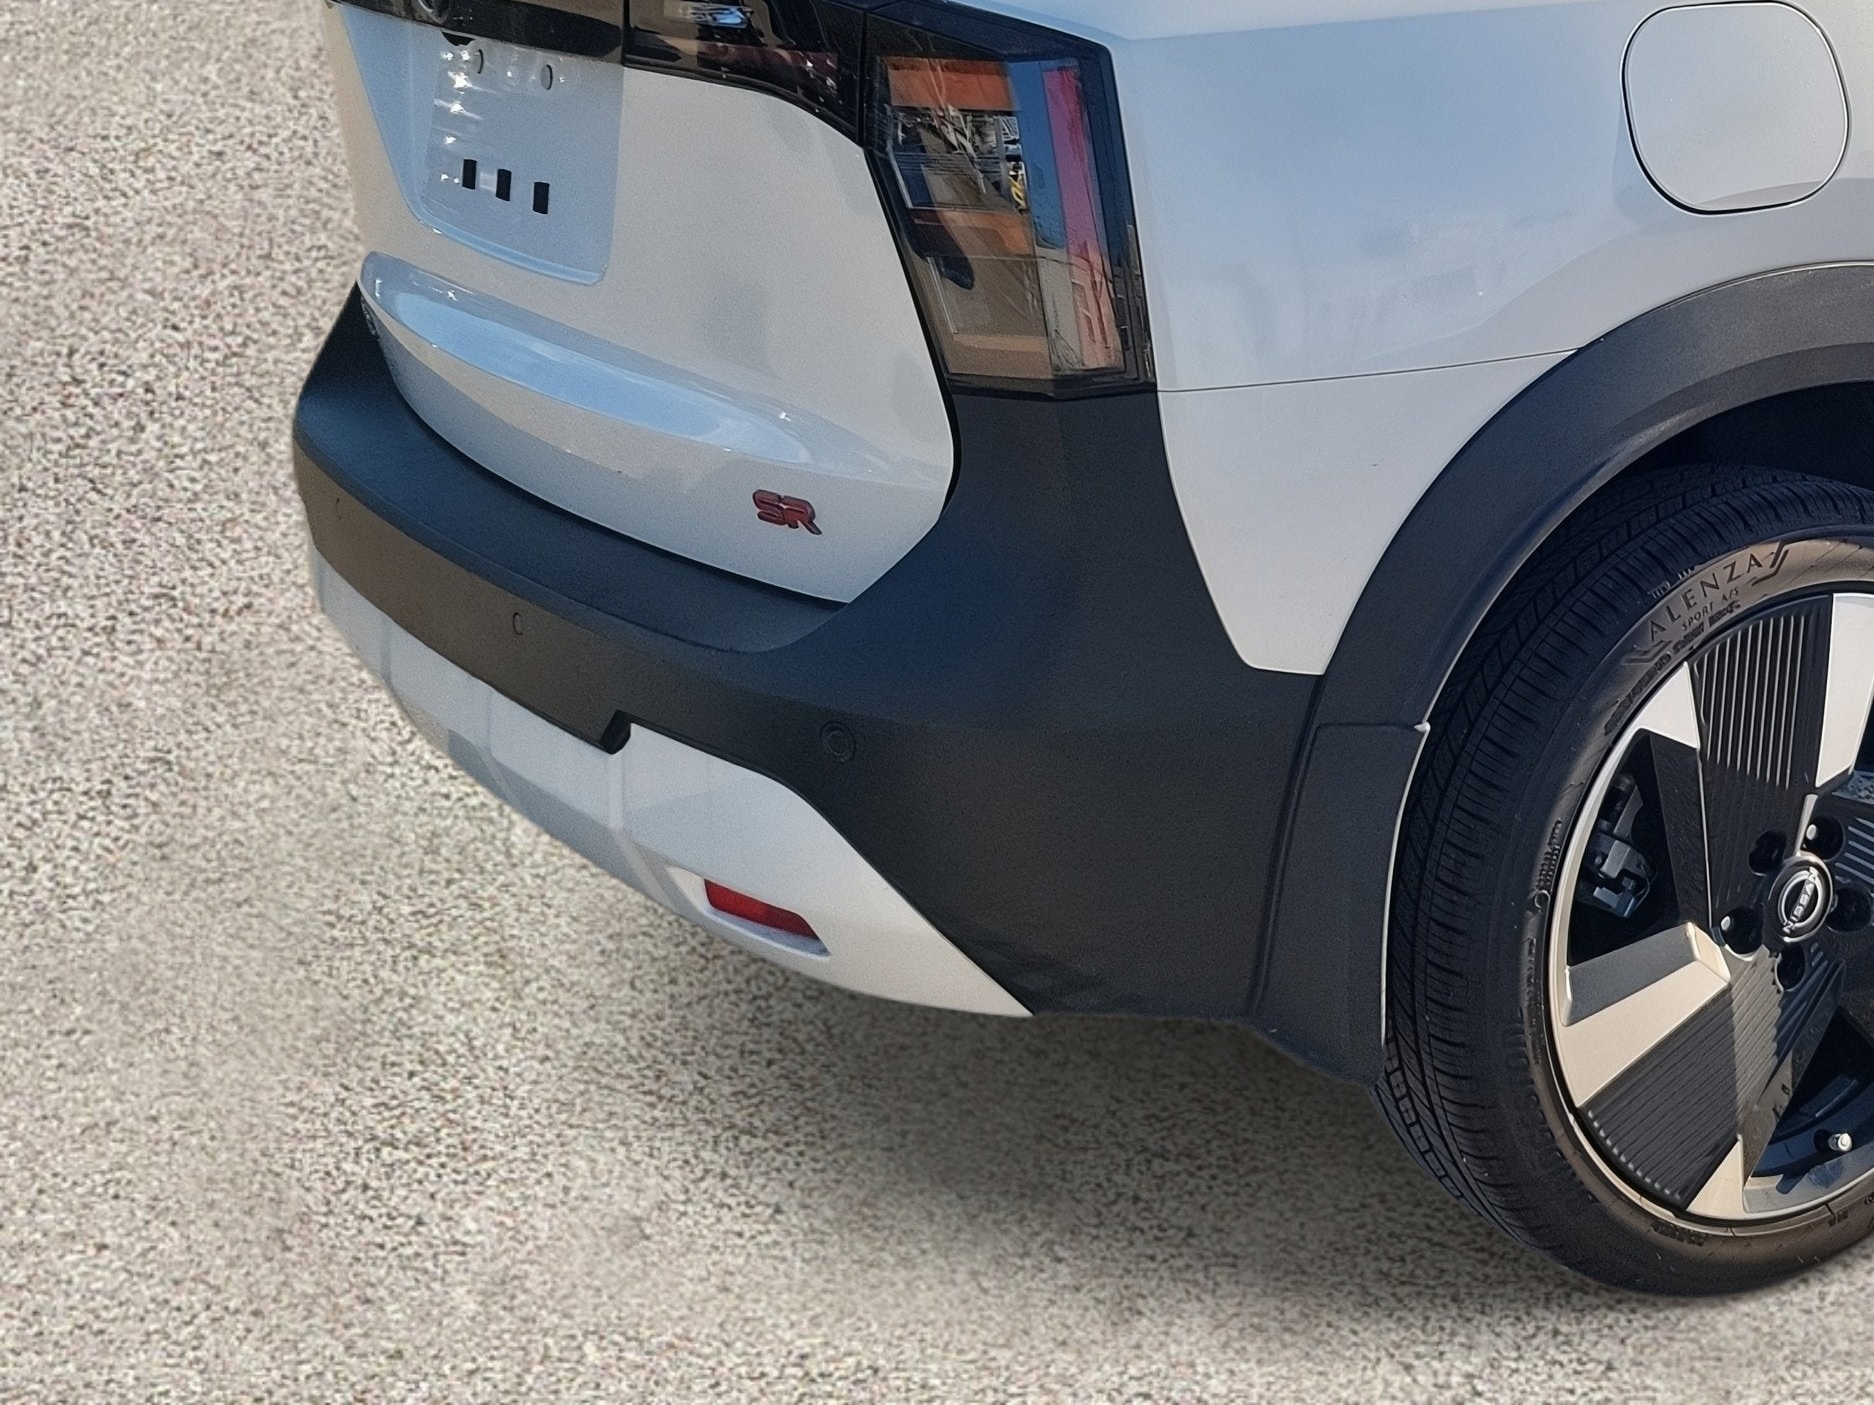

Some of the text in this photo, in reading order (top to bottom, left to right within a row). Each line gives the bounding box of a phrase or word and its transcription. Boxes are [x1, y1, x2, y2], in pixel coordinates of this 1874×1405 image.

[752, 489, 822, 535] SR
[1649, 551, 1763, 643] ALENZA
[1682, 602, 1714, 631] SPORT
